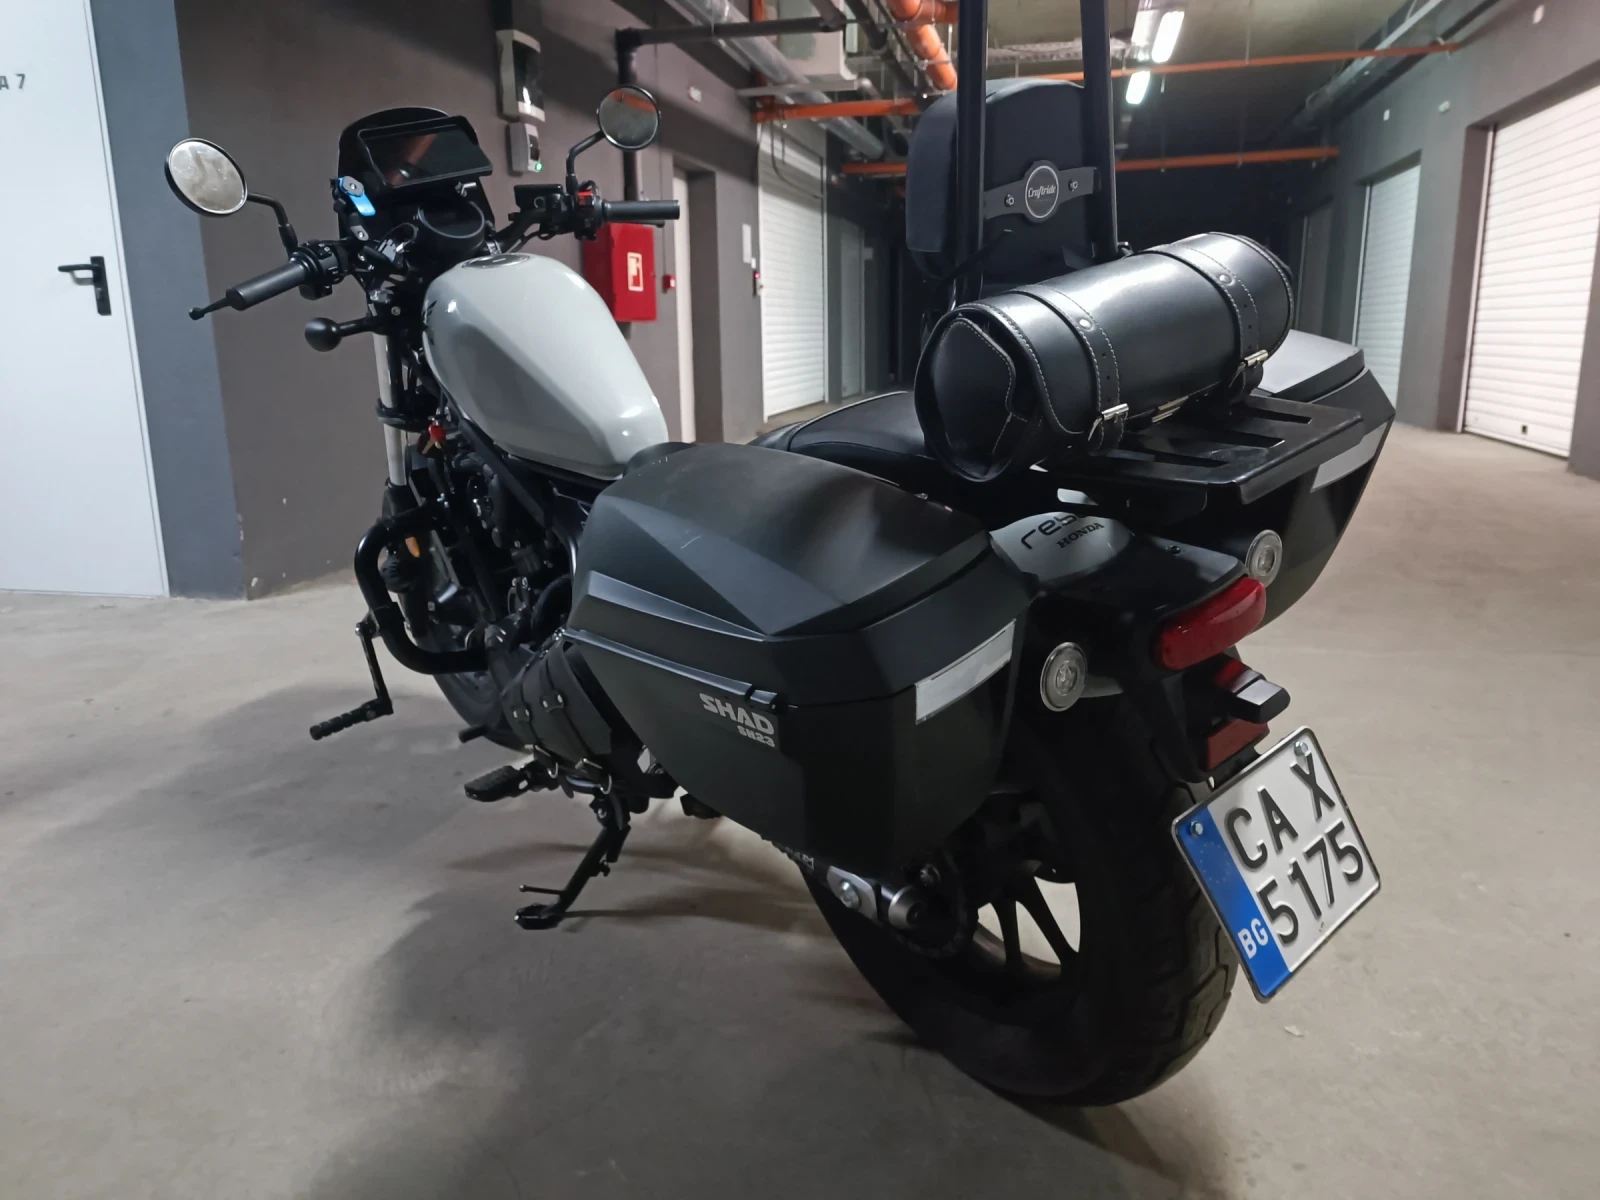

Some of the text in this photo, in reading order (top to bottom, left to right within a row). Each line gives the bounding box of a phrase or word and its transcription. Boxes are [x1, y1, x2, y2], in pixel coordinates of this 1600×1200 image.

[16, 73, 26, 89] 7
[1021, 514, 1078, 550] reb
[1056, 522, 1105, 549] HONDA
[699, 693, 775, 735] SHAD
[1226, 752, 1335, 869] CA X
[1257, 818, 1363, 945] 5175
[1237, 918, 1269, 959] BG
